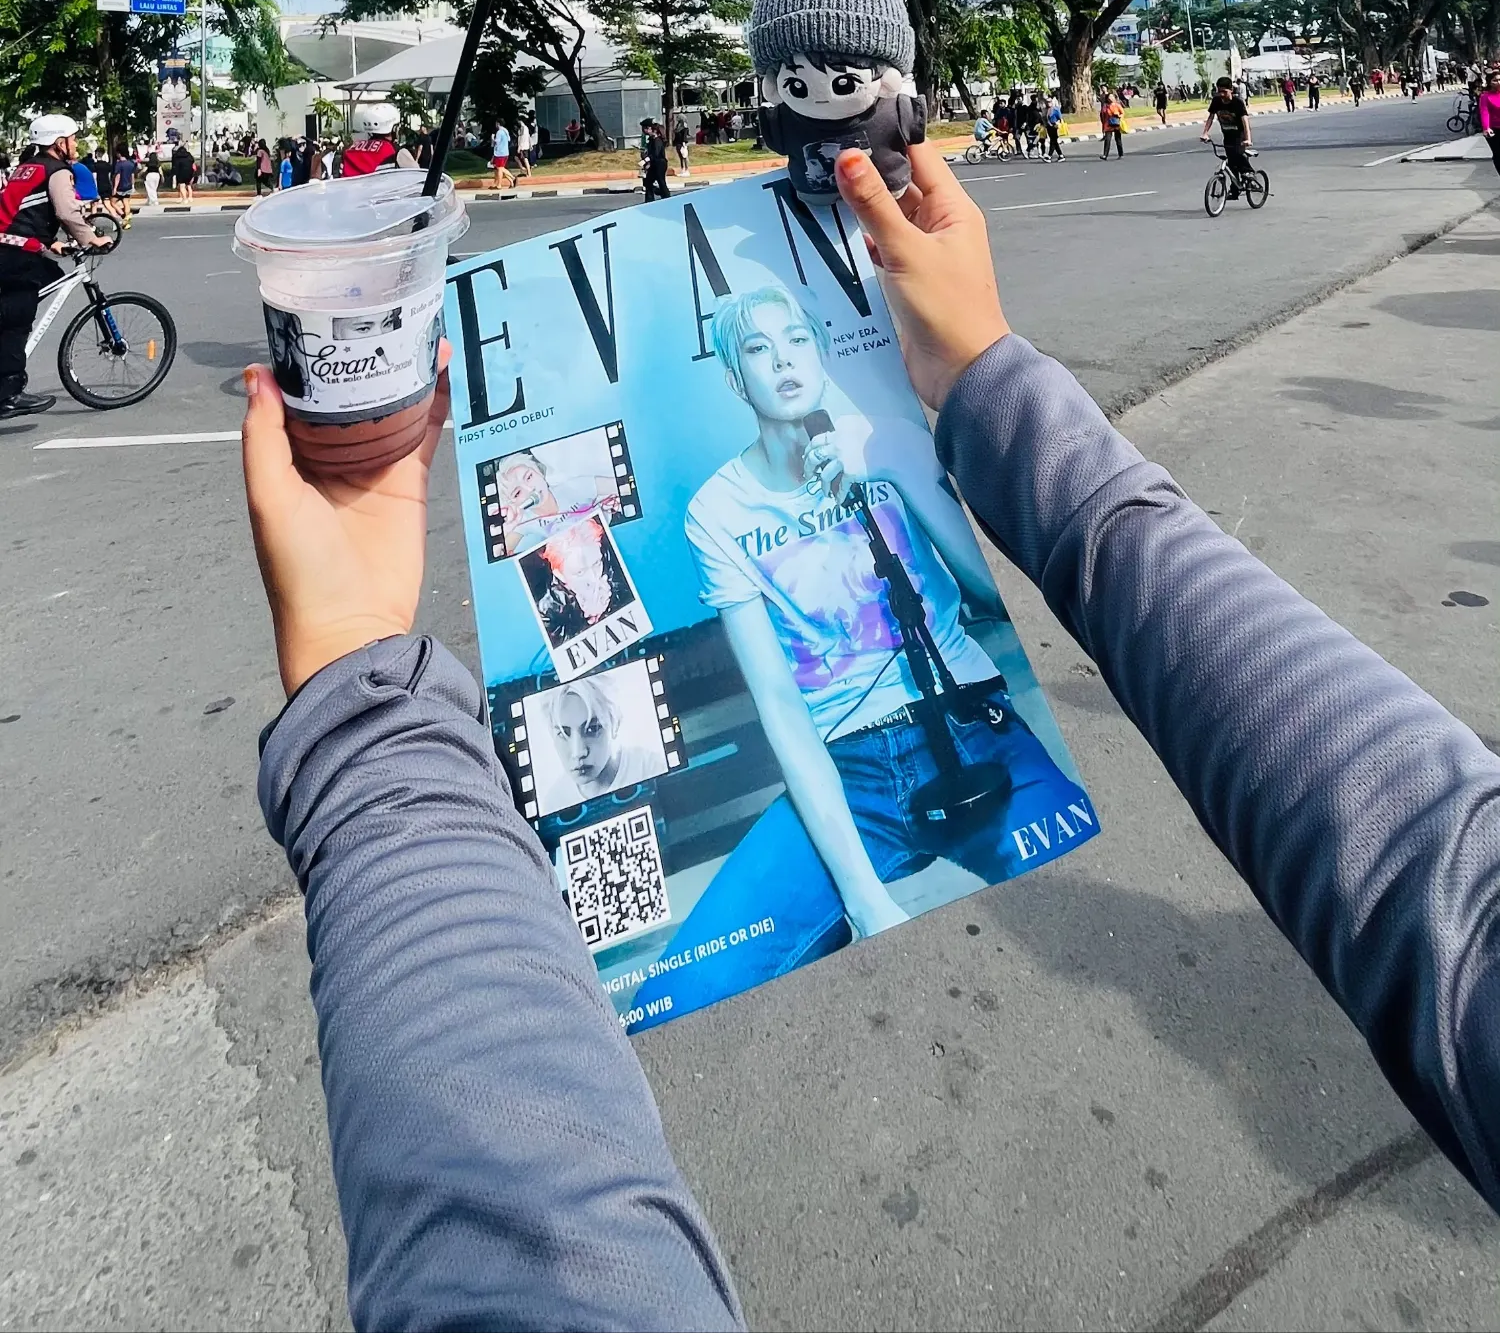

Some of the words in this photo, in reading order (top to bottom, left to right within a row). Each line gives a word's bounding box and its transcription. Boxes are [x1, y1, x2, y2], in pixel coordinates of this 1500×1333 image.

[349, 140, 384, 153] POLISI
[446, 177, 872, 431] EVAN
[833, 331, 856, 345] NEW
[858, 325, 879, 339] ERA
[837, 344, 860, 358] NEW
[862, 336, 892, 352] EVAN
[295, 332, 377, 384] Evan
[342, 374, 362, 384] solo
[458, 429, 485, 445] FIRST
[489, 419, 518, 436] SOLO
[521, 407, 555, 425] DEBUT
[735, 525, 789, 560] The
[798, 483, 889, 538] Smhs
[565, 610, 639, 672] EVAN
[1011, 798, 1093, 861] EVAN
[649, 949, 693, 979] SINGLE
[694, 935, 728, 963] (RIDE
[729, 928, 749, 946] OR
[750, 916, 776, 939] DIE)
[645, 995, 674, 1017] WIB
